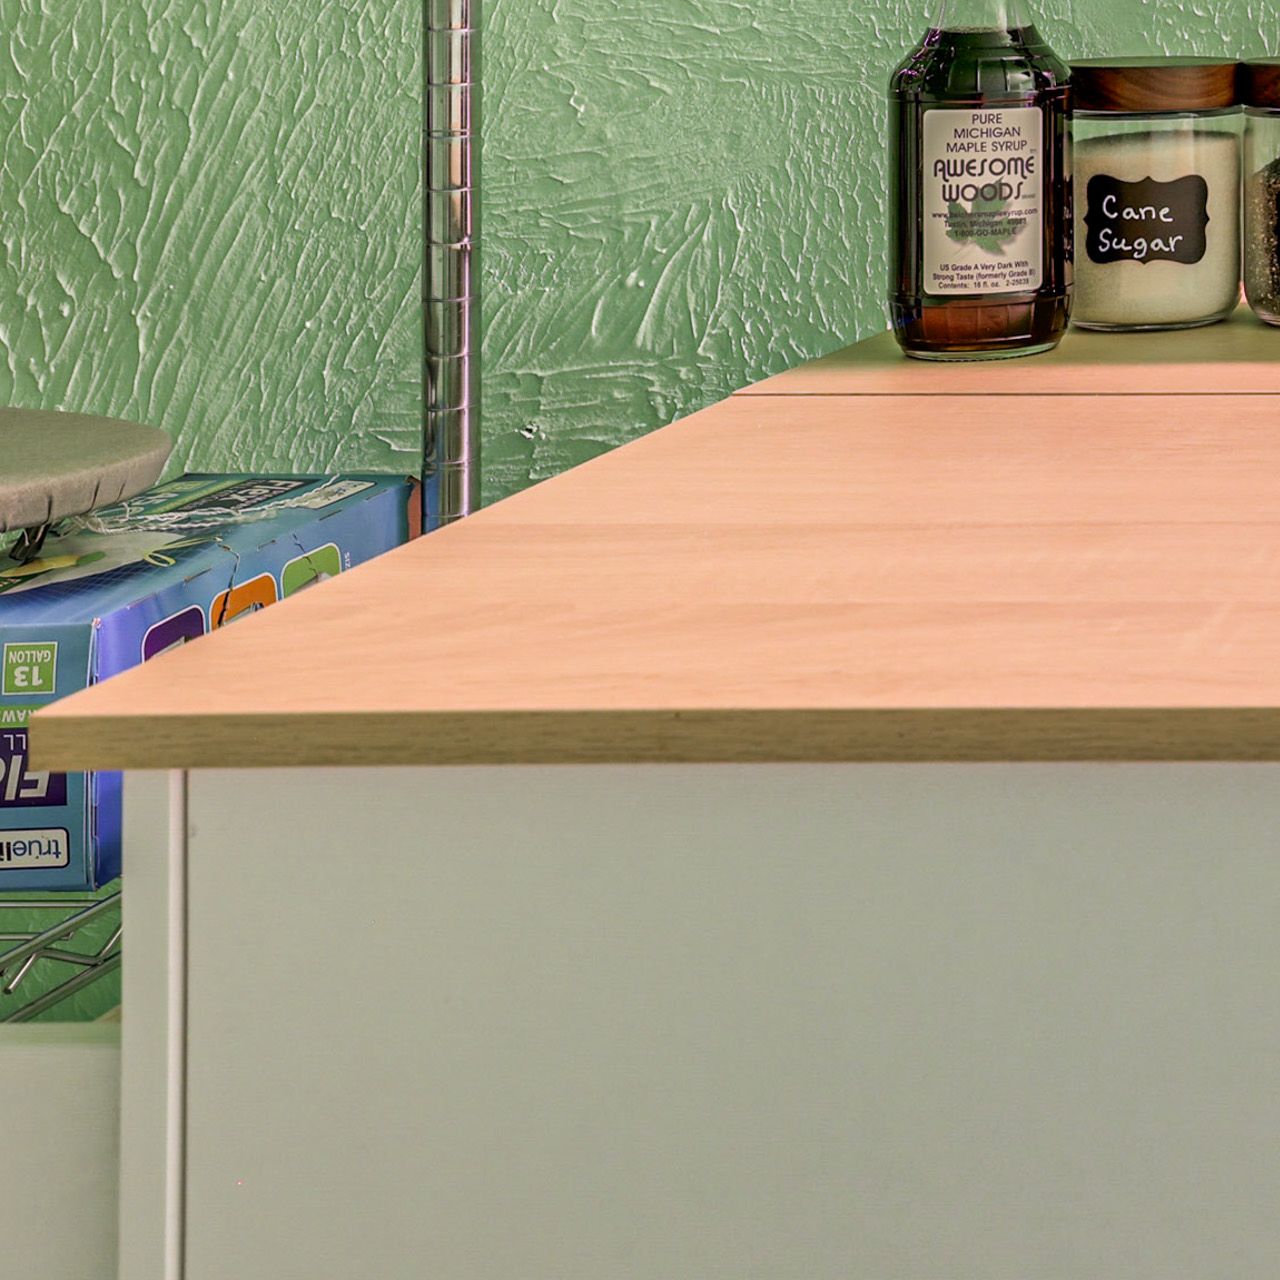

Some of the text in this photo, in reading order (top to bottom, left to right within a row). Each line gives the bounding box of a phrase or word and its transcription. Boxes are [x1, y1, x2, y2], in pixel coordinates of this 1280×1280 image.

[971, 113, 1003, 125] PURE
[953, 126, 1021, 139] MICHIGAN
[946, 142, 988, 153] MAPLE
[991, 140, 1028, 152] SYRUP
[934, 155, 1035, 182] AWESOME
[942, 181, 1024, 202] WOODS
[1102, 195, 1174, 222] Cane
[1098, 228, 1183, 258] Sugar
[940, 264, 950, 272] US
[951, 263, 972, 271] Grade
[980, 263, 996, 272] Very
[997, 261, 1013, 270] Dark
[1014, 260, 1029, 268] With
[933, 273, 954, 281] Strong
[976, 271, 1007, 281] (formerly
[1008, 269, 1028, 277] Grade
[938, 281, 968, 289] Contents:
[8, 649, 52, 664] GALLON
[13, 666, 44, 687] 13
[0, 709, 37, 722] AW
[3, 734, 27, 751] LL
[0, 838, 62, 867] trueli
